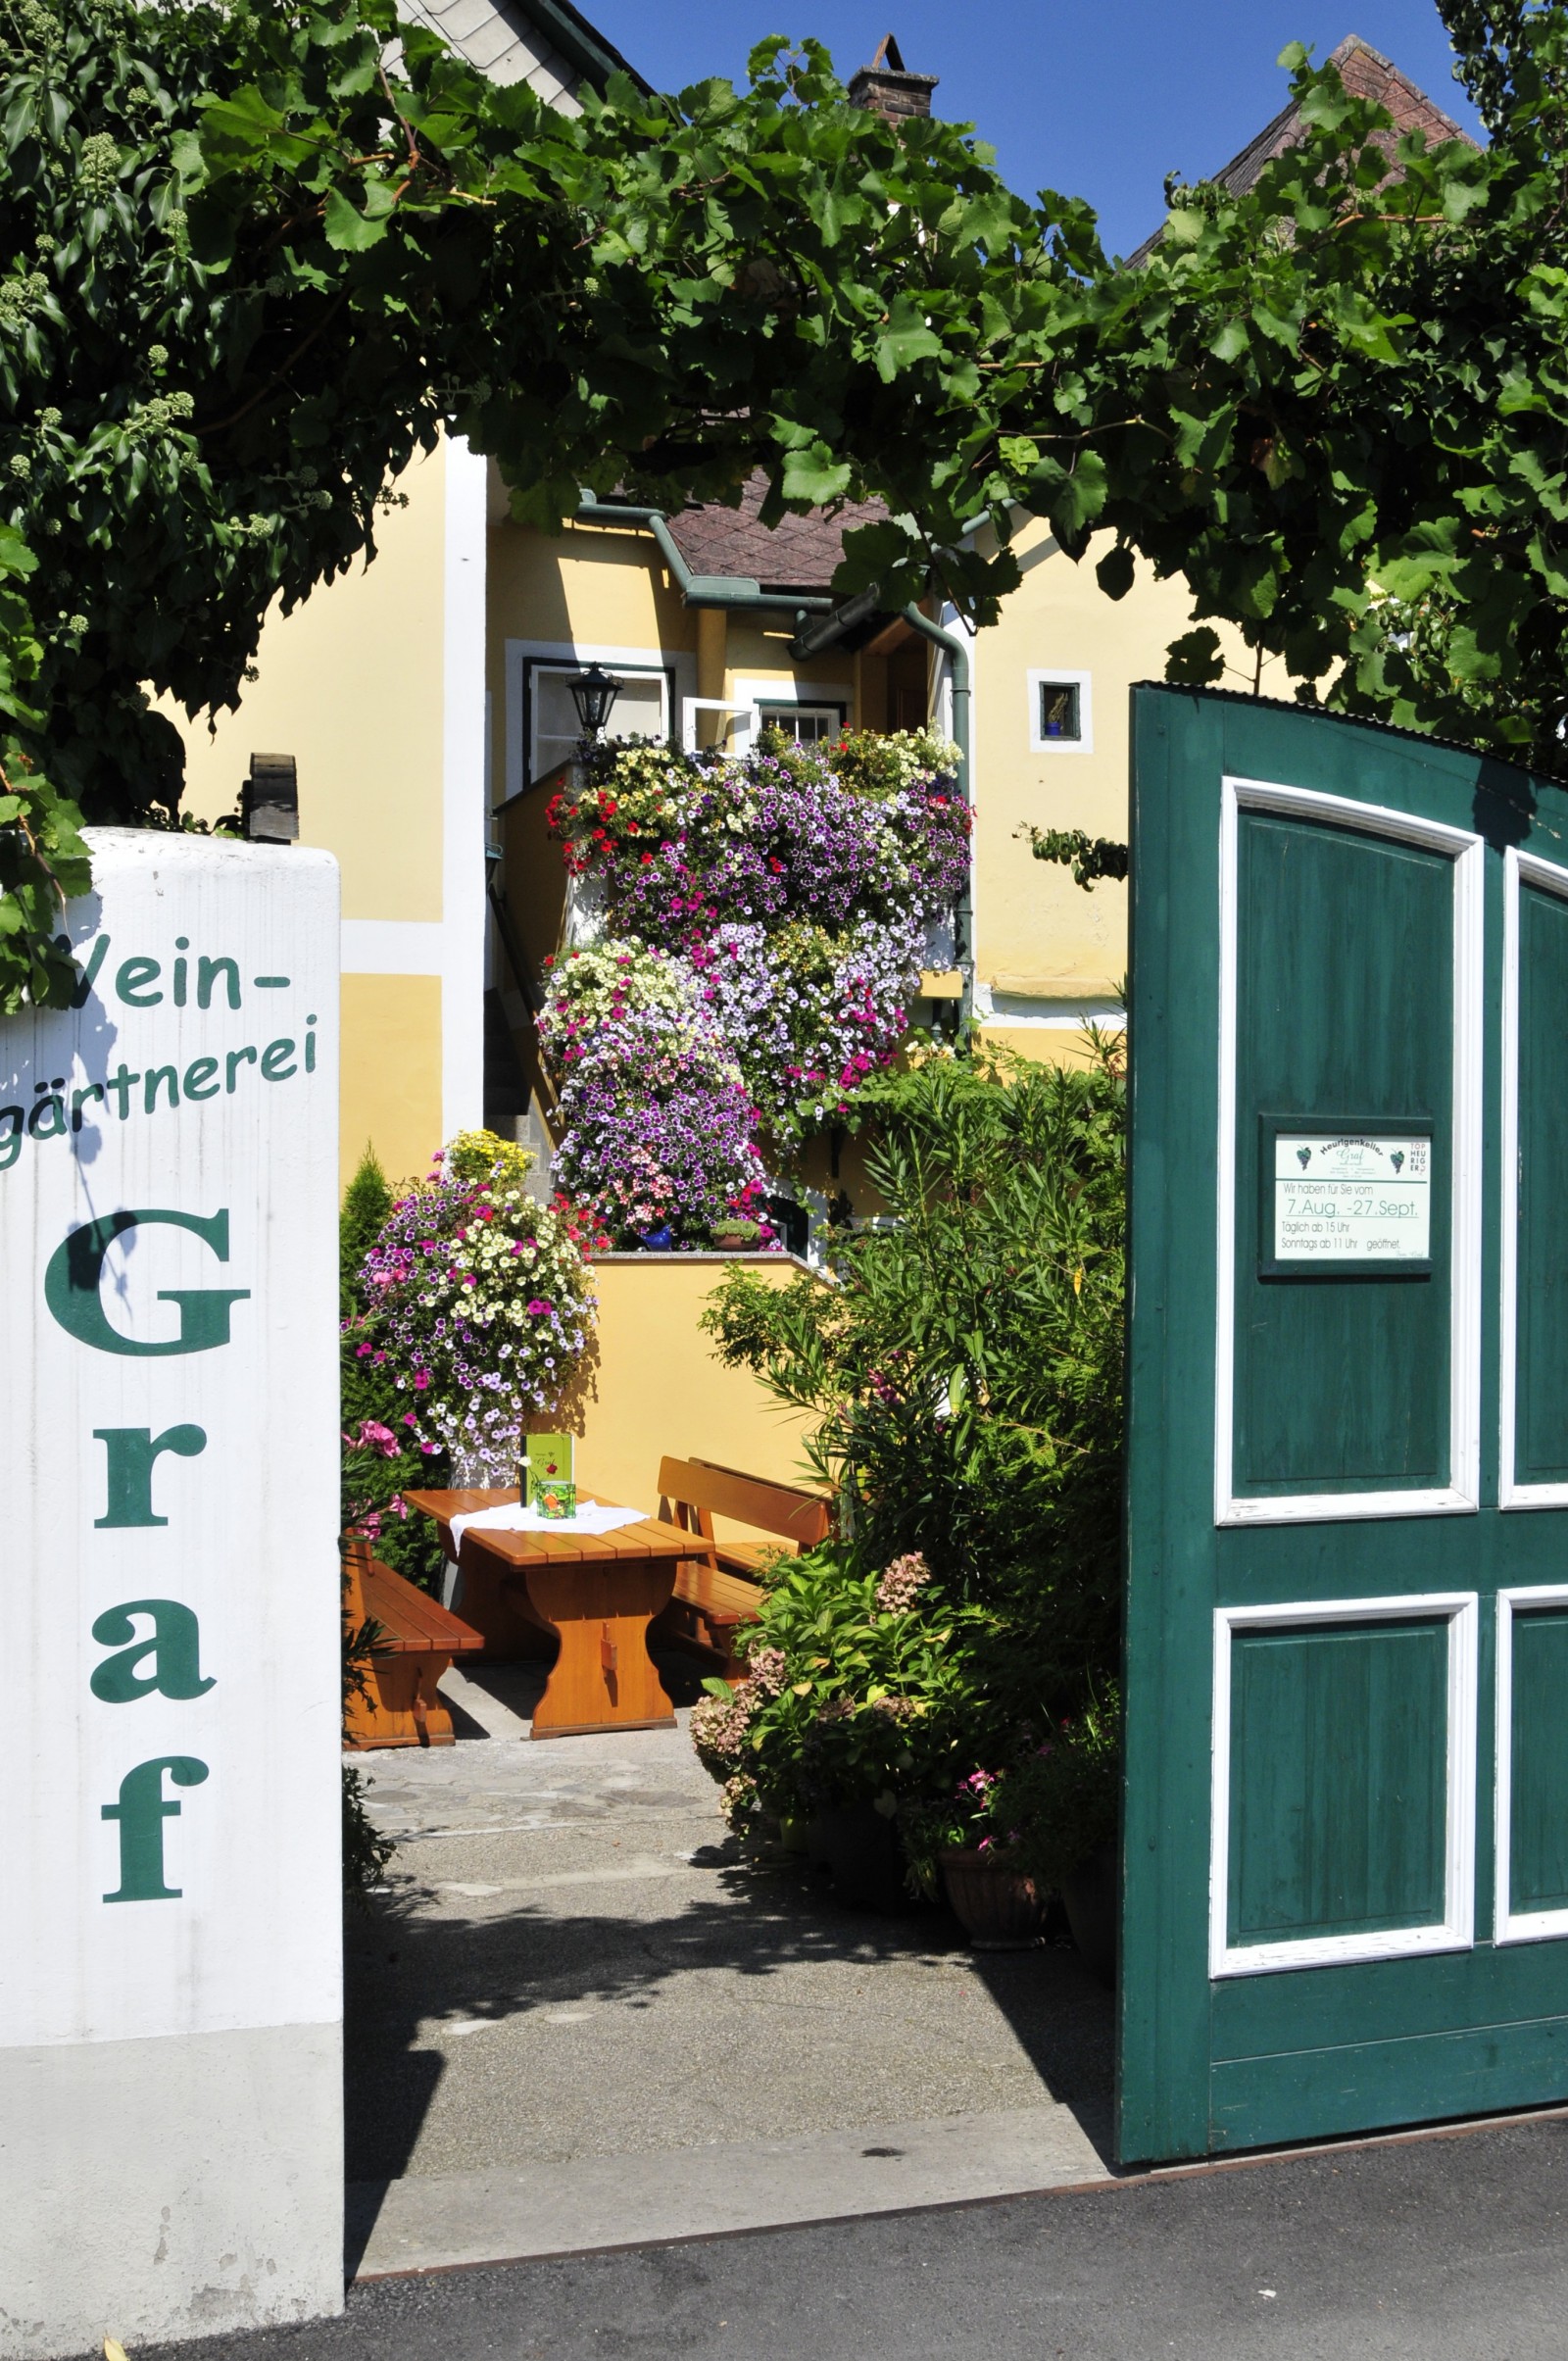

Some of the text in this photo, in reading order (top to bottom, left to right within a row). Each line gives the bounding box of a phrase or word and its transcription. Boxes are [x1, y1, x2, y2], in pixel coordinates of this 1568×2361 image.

[0, 1013, 318, 1171] gärtnerei
[1319, 1138, 1384, 1156] Heurigenkeller
[1336, 1147, 1364, 1164] Graf
[1284, 1183, 1374, 1195] Wir haben für Sie vom
[1282, 1221, 1349, 1235] Täglich ab 15 Uhr
[1281, 1237, 1318, 1251] Sonntags
[1319, 1238, 1331, 1249] ab
[1334, 1238, 1342, 1249] 11
[1346, 1238, 1357, 1249] Uhr
[44, 1207, 251, 1904] Graf
